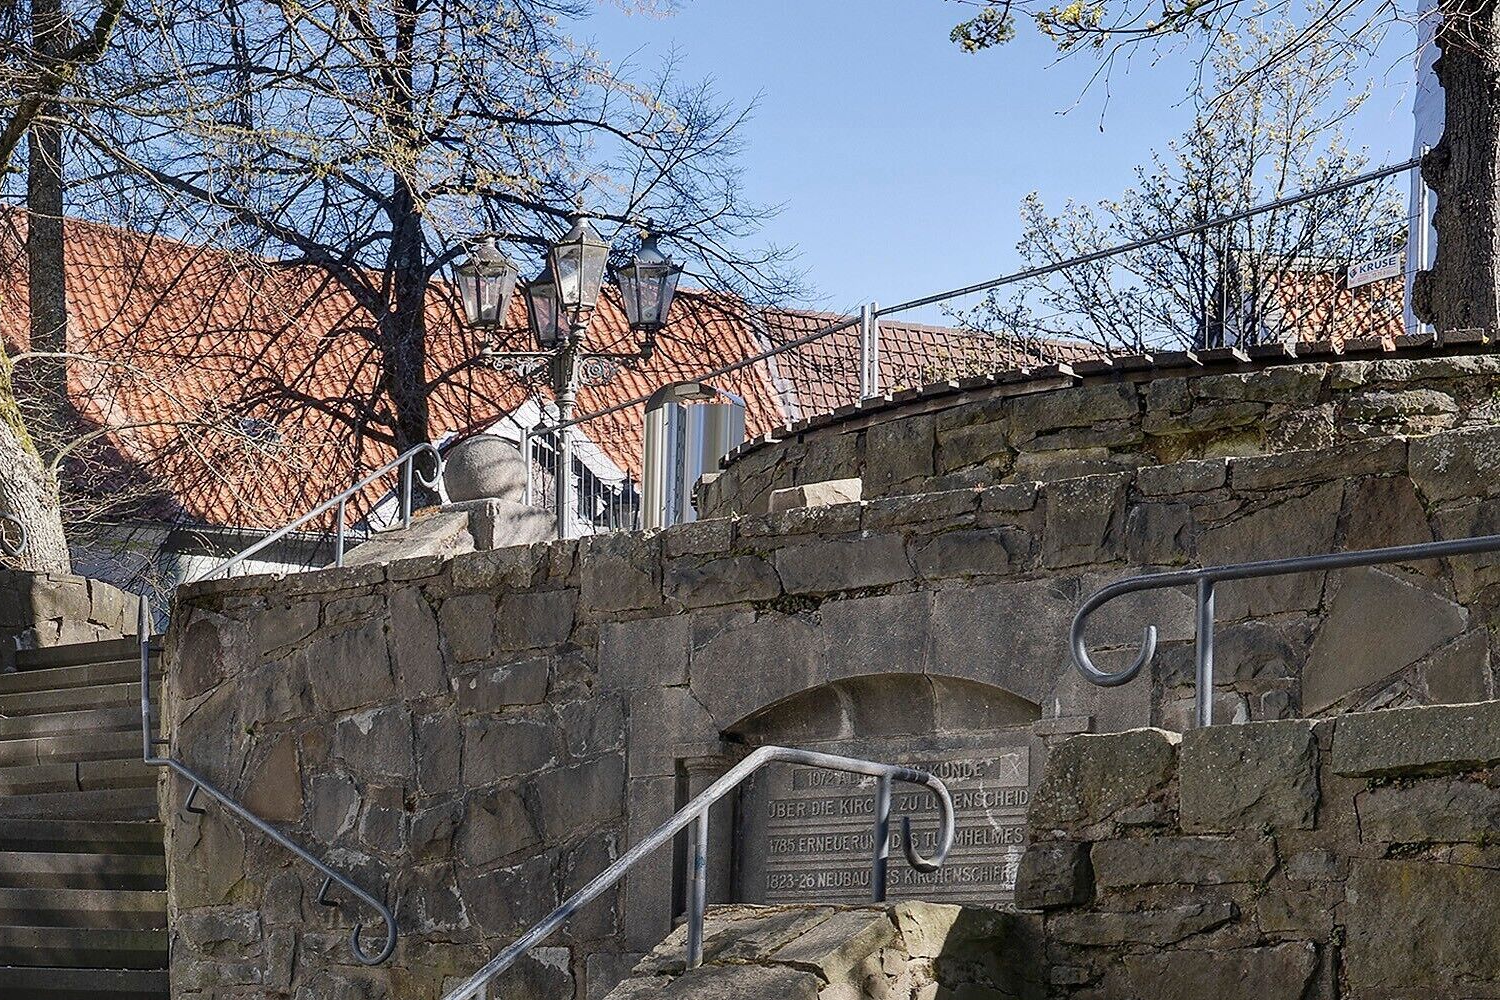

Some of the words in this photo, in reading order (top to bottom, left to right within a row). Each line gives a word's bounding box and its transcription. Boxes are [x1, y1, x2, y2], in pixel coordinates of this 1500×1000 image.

[1359, 256, 1396, 274] KRUSE
[921, 762, 985, 779] KUNDE
[768, 801, 806, 818] ÜBER
[811, 800, 835, 816] DIE
[839, 798, 877, 815] KIRC
[899, 796, 918, 811] ZU
[769, 839, 796, 853] 1785
[798, 834, 878, 852] ERNEUERUN
[892, 832, 919, 849] DS
[924, 827, 1024, 847] TUMHELMES
[765, 872, 815, 889] 1823-26
[817, 870, 870, 887] NEUBAU
